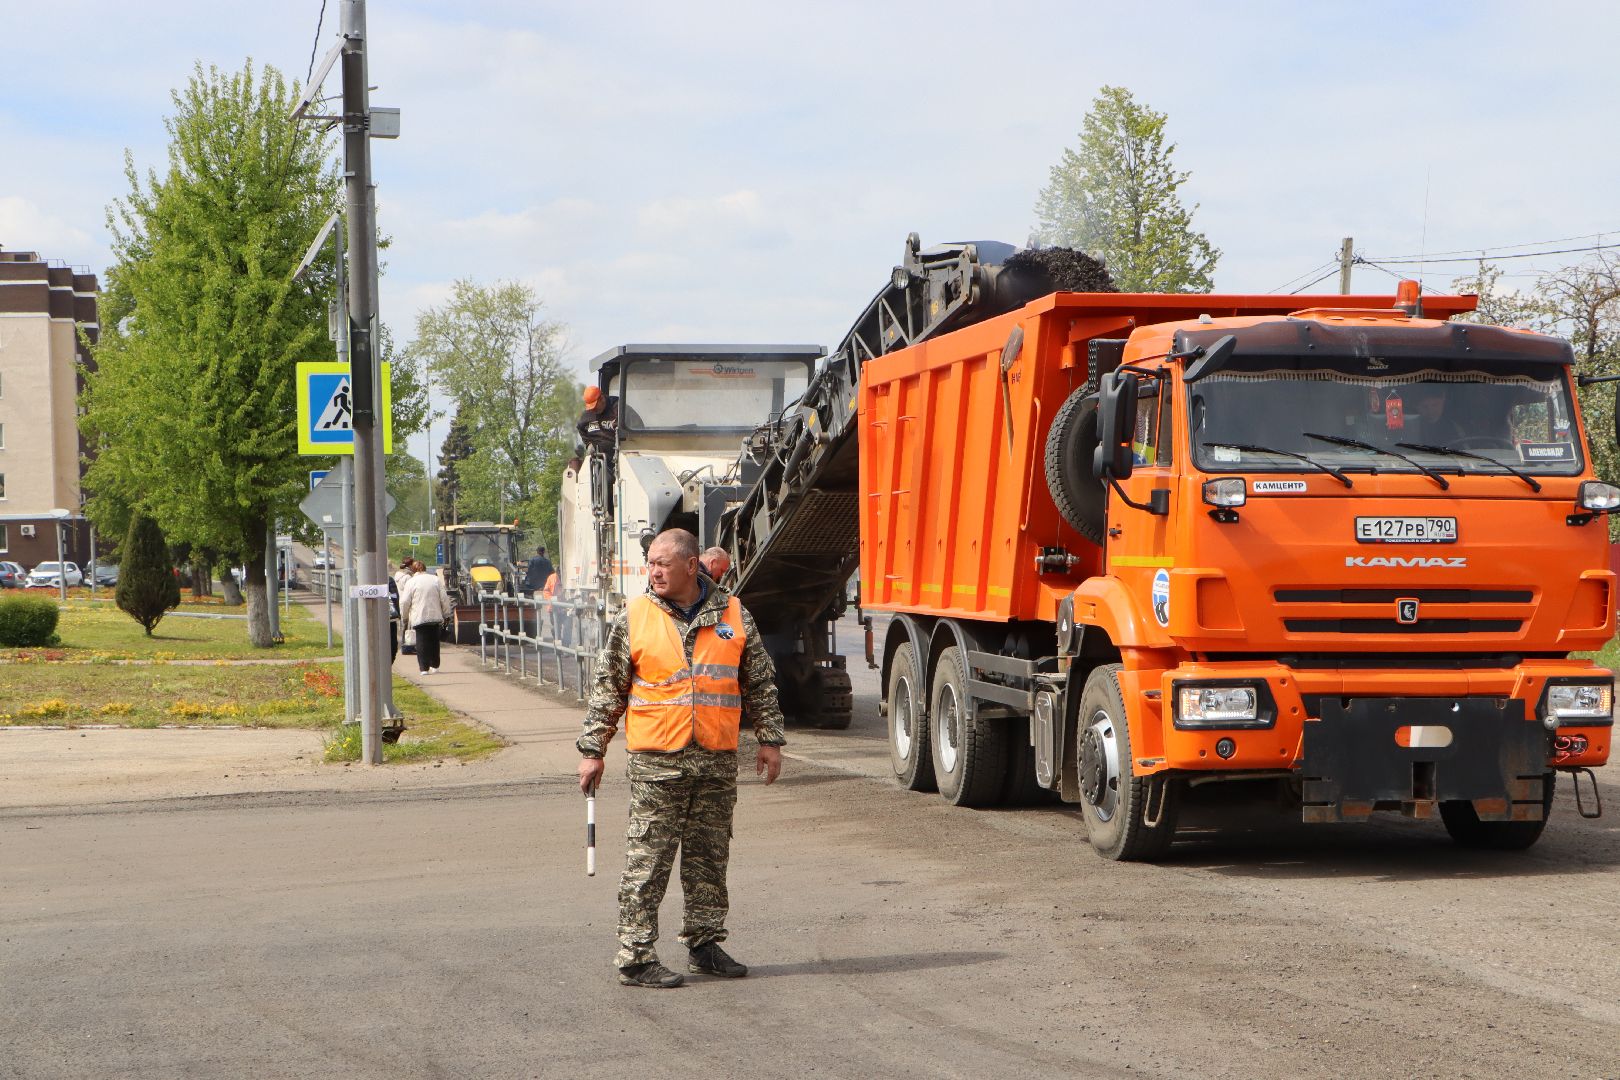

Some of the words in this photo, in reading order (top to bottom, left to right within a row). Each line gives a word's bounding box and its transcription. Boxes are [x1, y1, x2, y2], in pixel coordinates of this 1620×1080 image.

[1255, 482, 1304, 490] КАМЦЕНТР
[1362, 520, 1425, 536] Е127РВ
[1428, 519, 1451, 532] 790
[1345, 556, 1467, 567] KAMAZ
